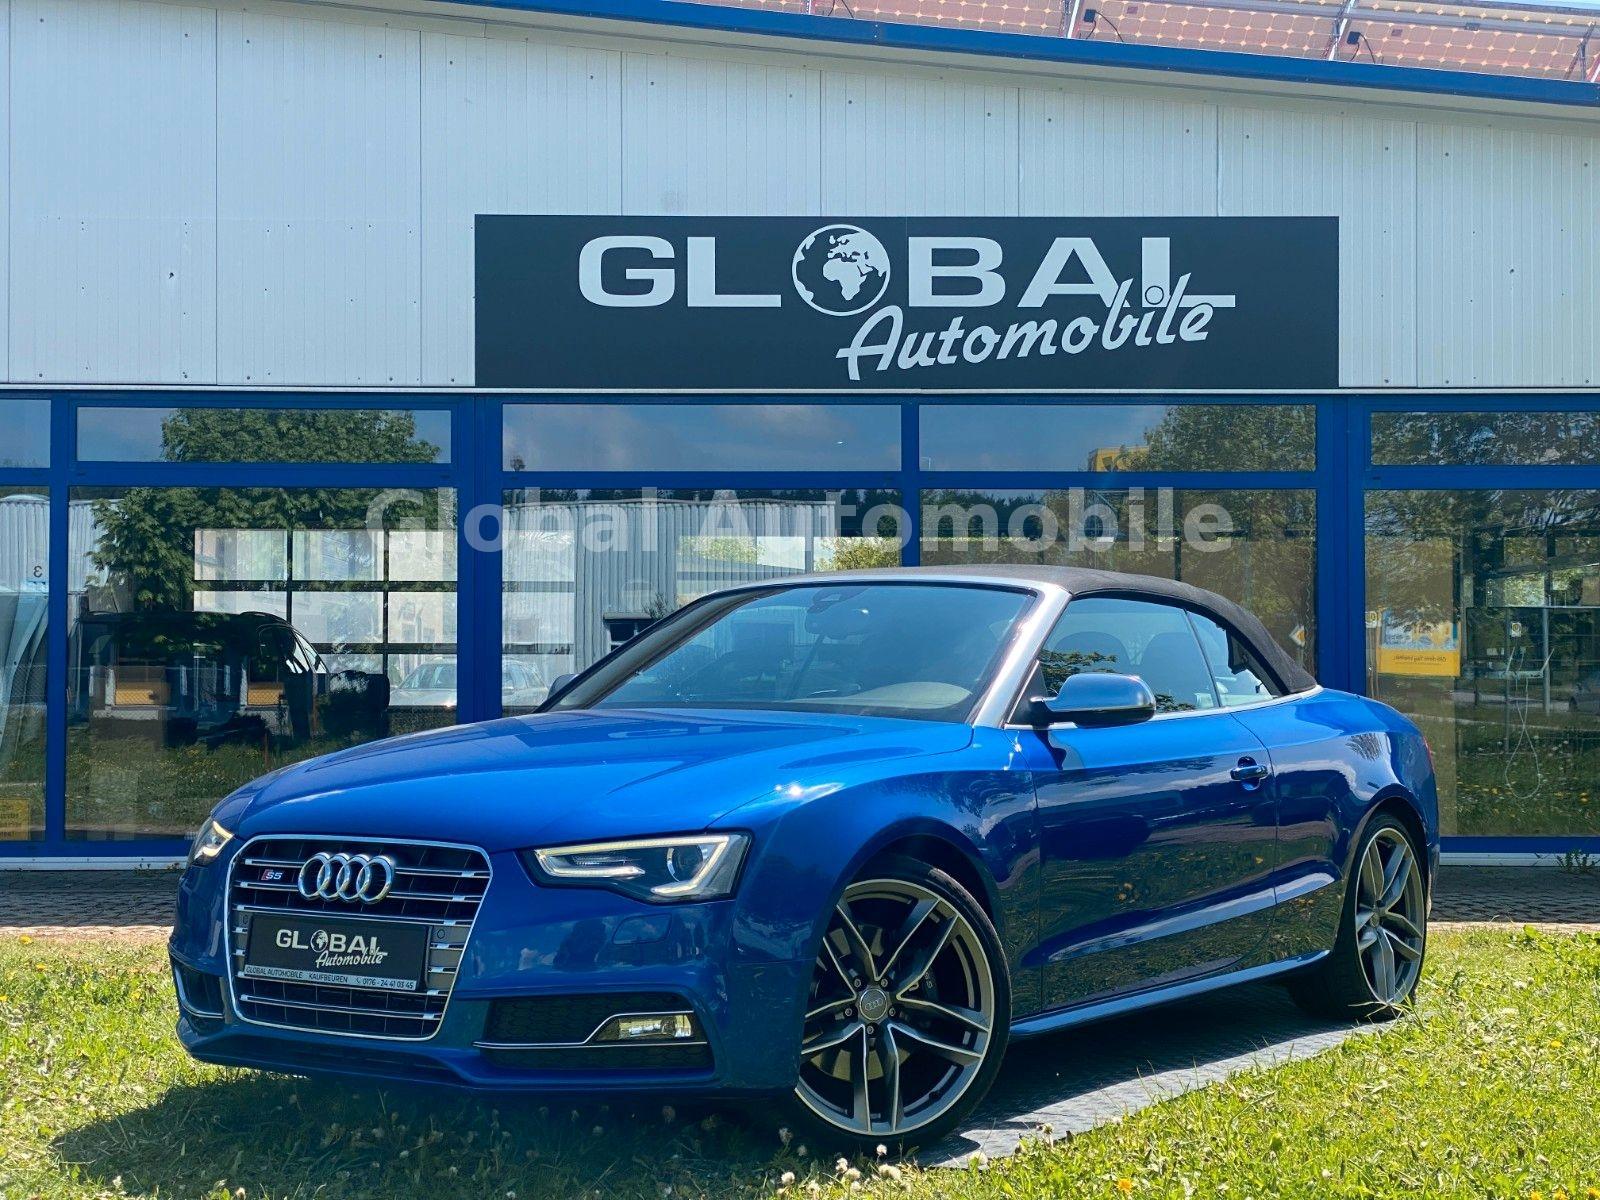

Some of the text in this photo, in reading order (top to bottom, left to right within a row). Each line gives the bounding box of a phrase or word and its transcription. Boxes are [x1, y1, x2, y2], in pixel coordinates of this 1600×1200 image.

[579, 224, 1235, 317] GLOBAL
[836, 272, 1213, 380] Automobile
[265, 871, 283, 880] S5
[276, 929, 388, 956] GLOBAL
[315, 946, 384, 968] Automobile
[246, 967, 266, 975] GLOBAL
[267, 969, 303, 979] AUTOMOBILE
[309, 973, 348, 983] KAUFBEUREN
[381, 980, 389, 988] 24
